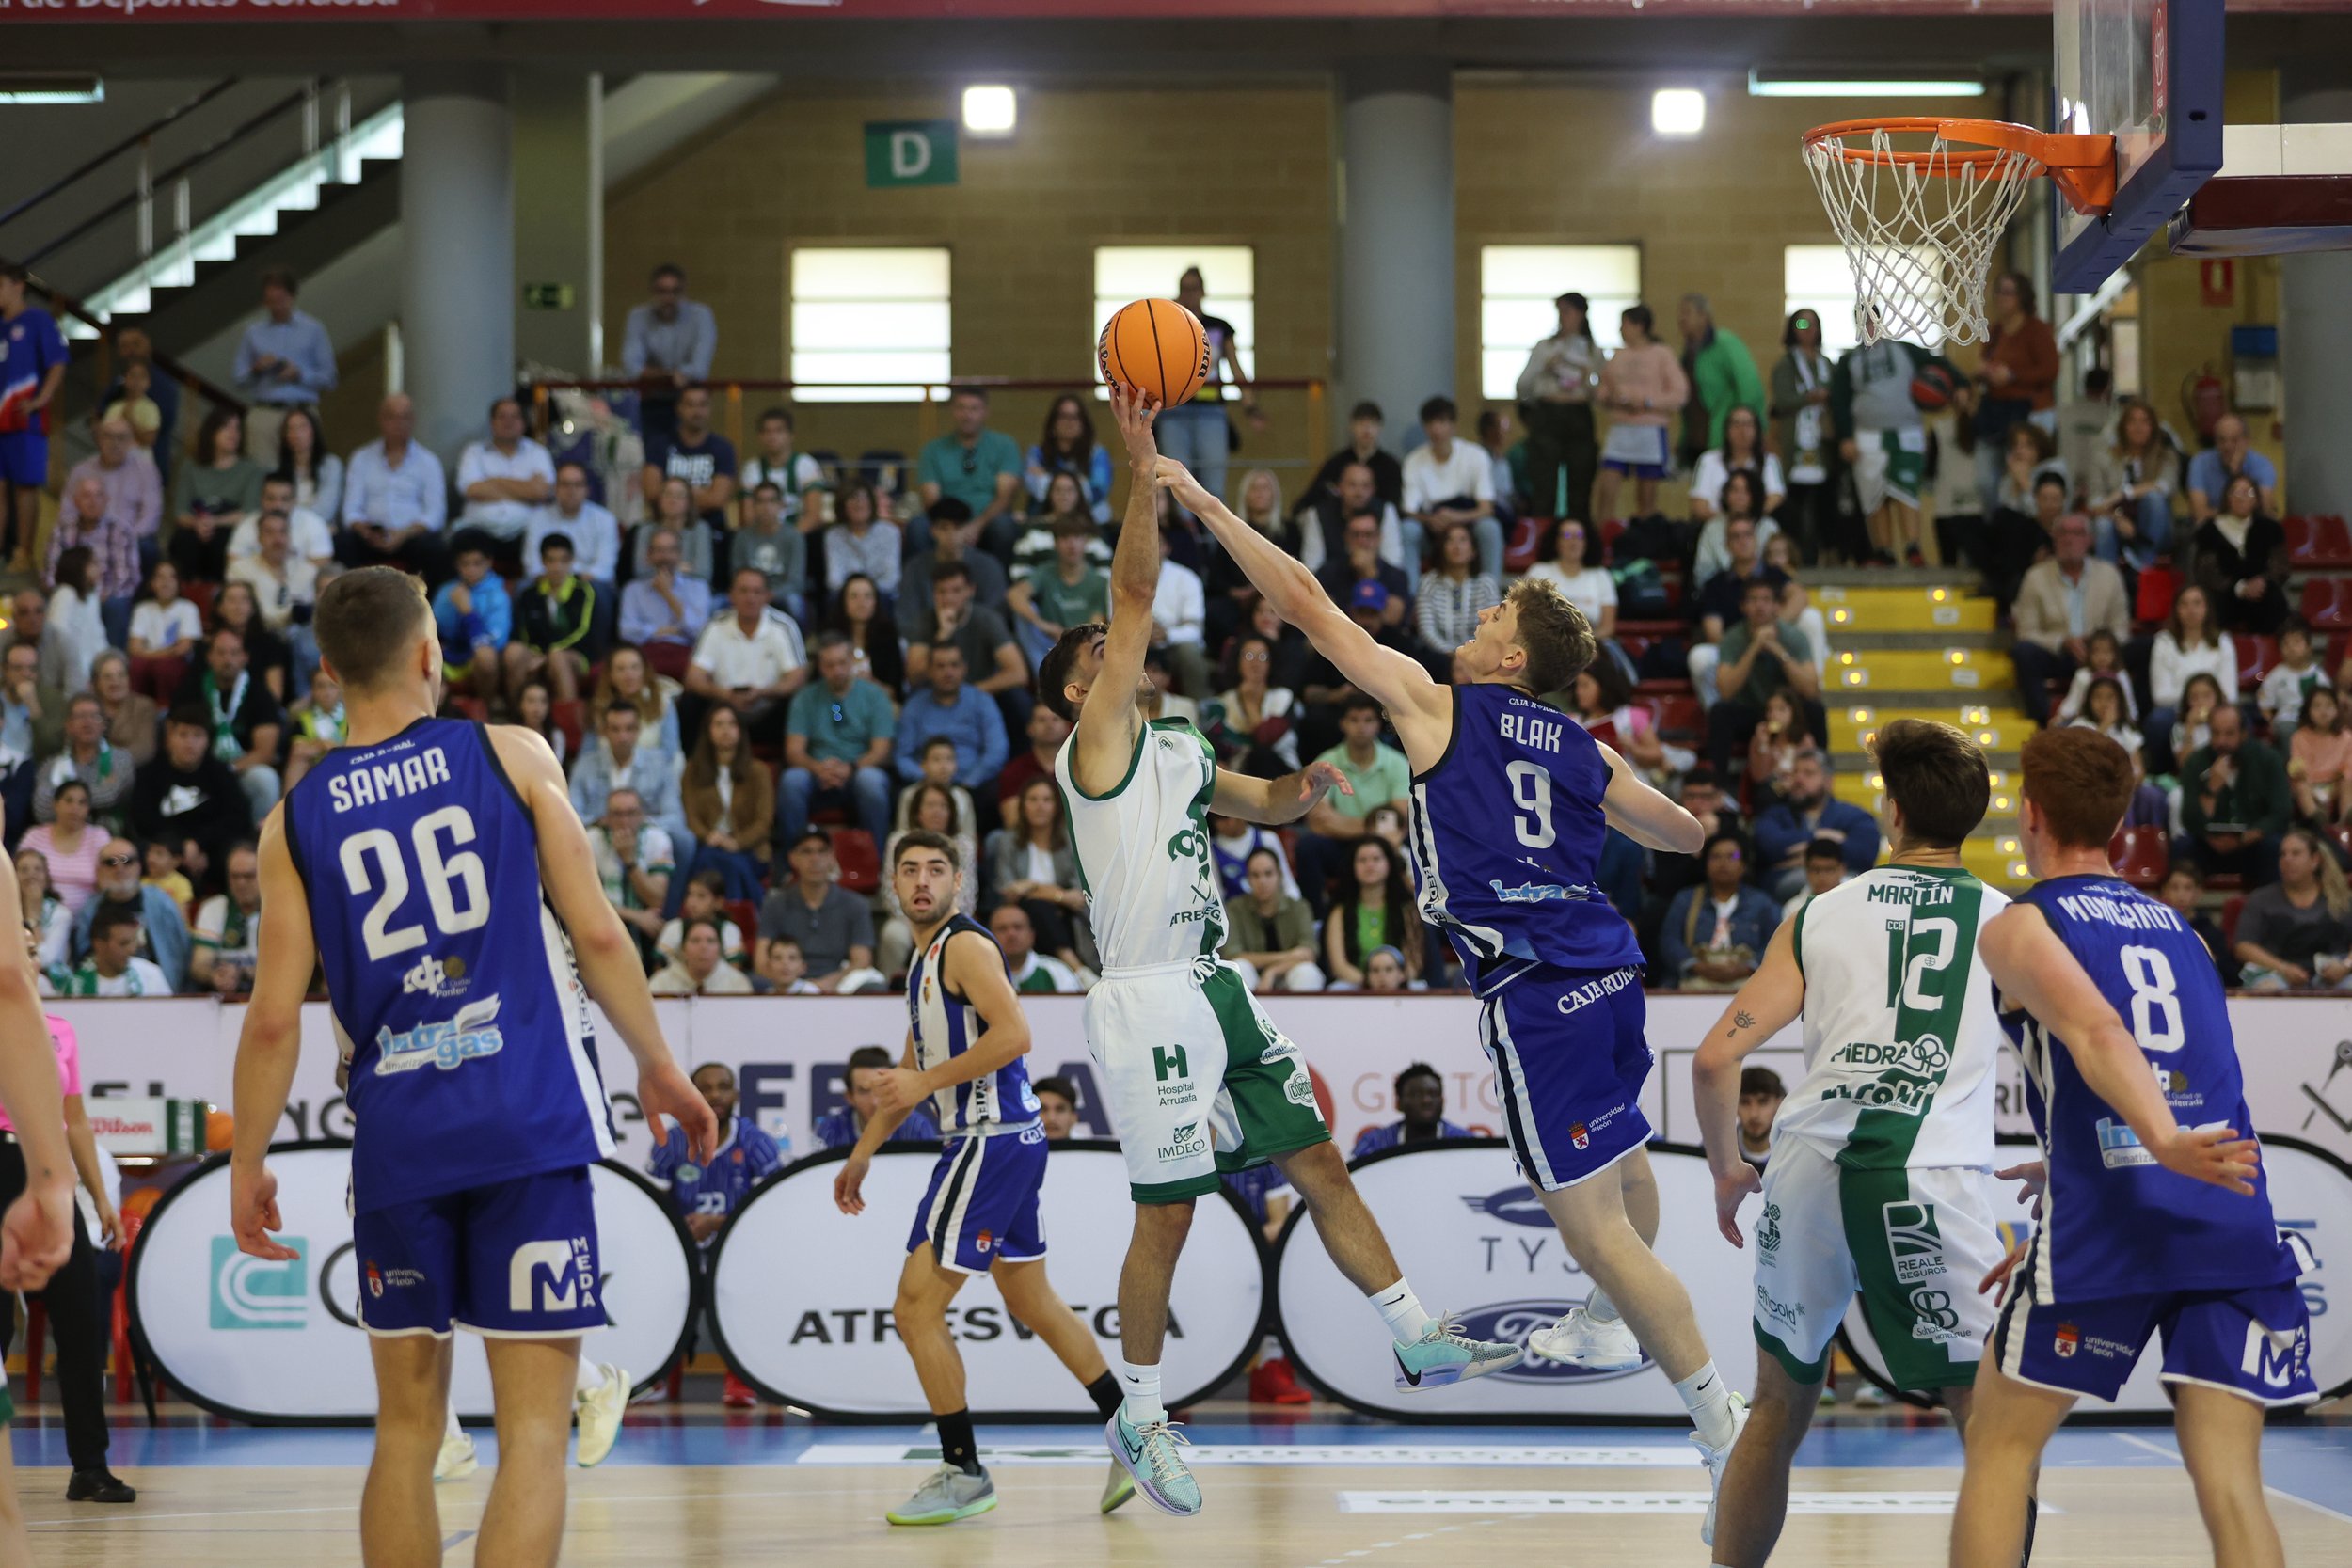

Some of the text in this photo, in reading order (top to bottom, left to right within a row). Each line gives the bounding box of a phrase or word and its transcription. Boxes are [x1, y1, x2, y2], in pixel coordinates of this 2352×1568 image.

[890, 131, 930, 178] D
[1508, 697, 1530, 708] CAJA
[1500, 712, 1563, 753] BLAK
[329, 747, 451, 813] SAMAR
[1505, 760, 1556, 849] 9
[339, 805, 491, 962] 26
[1867, 884, 1954, 906] MARTÍN
[1887, 920, 1904, 930] CCB
[1885, 917, 1958, 1011] 12
[1557, 980, 1603, 1015] CAJA
[2120, 944, 2185, 1053] 8
[437, 1028, 503, 1070] gas
[1157, 1082, 1195, 1096] Hospital
[1159, 1092, 1198, 1107] Arruzafa
[2166, 1099, 2204, 1107] onferrada
[1588, 1102, 1626, 1129] universidad
[572, 1236, 596, 1308] MEDA
[1898, 1256, 1944, 1272] REALE
[1899, 1266, 1947, 1280] SEGUROS
